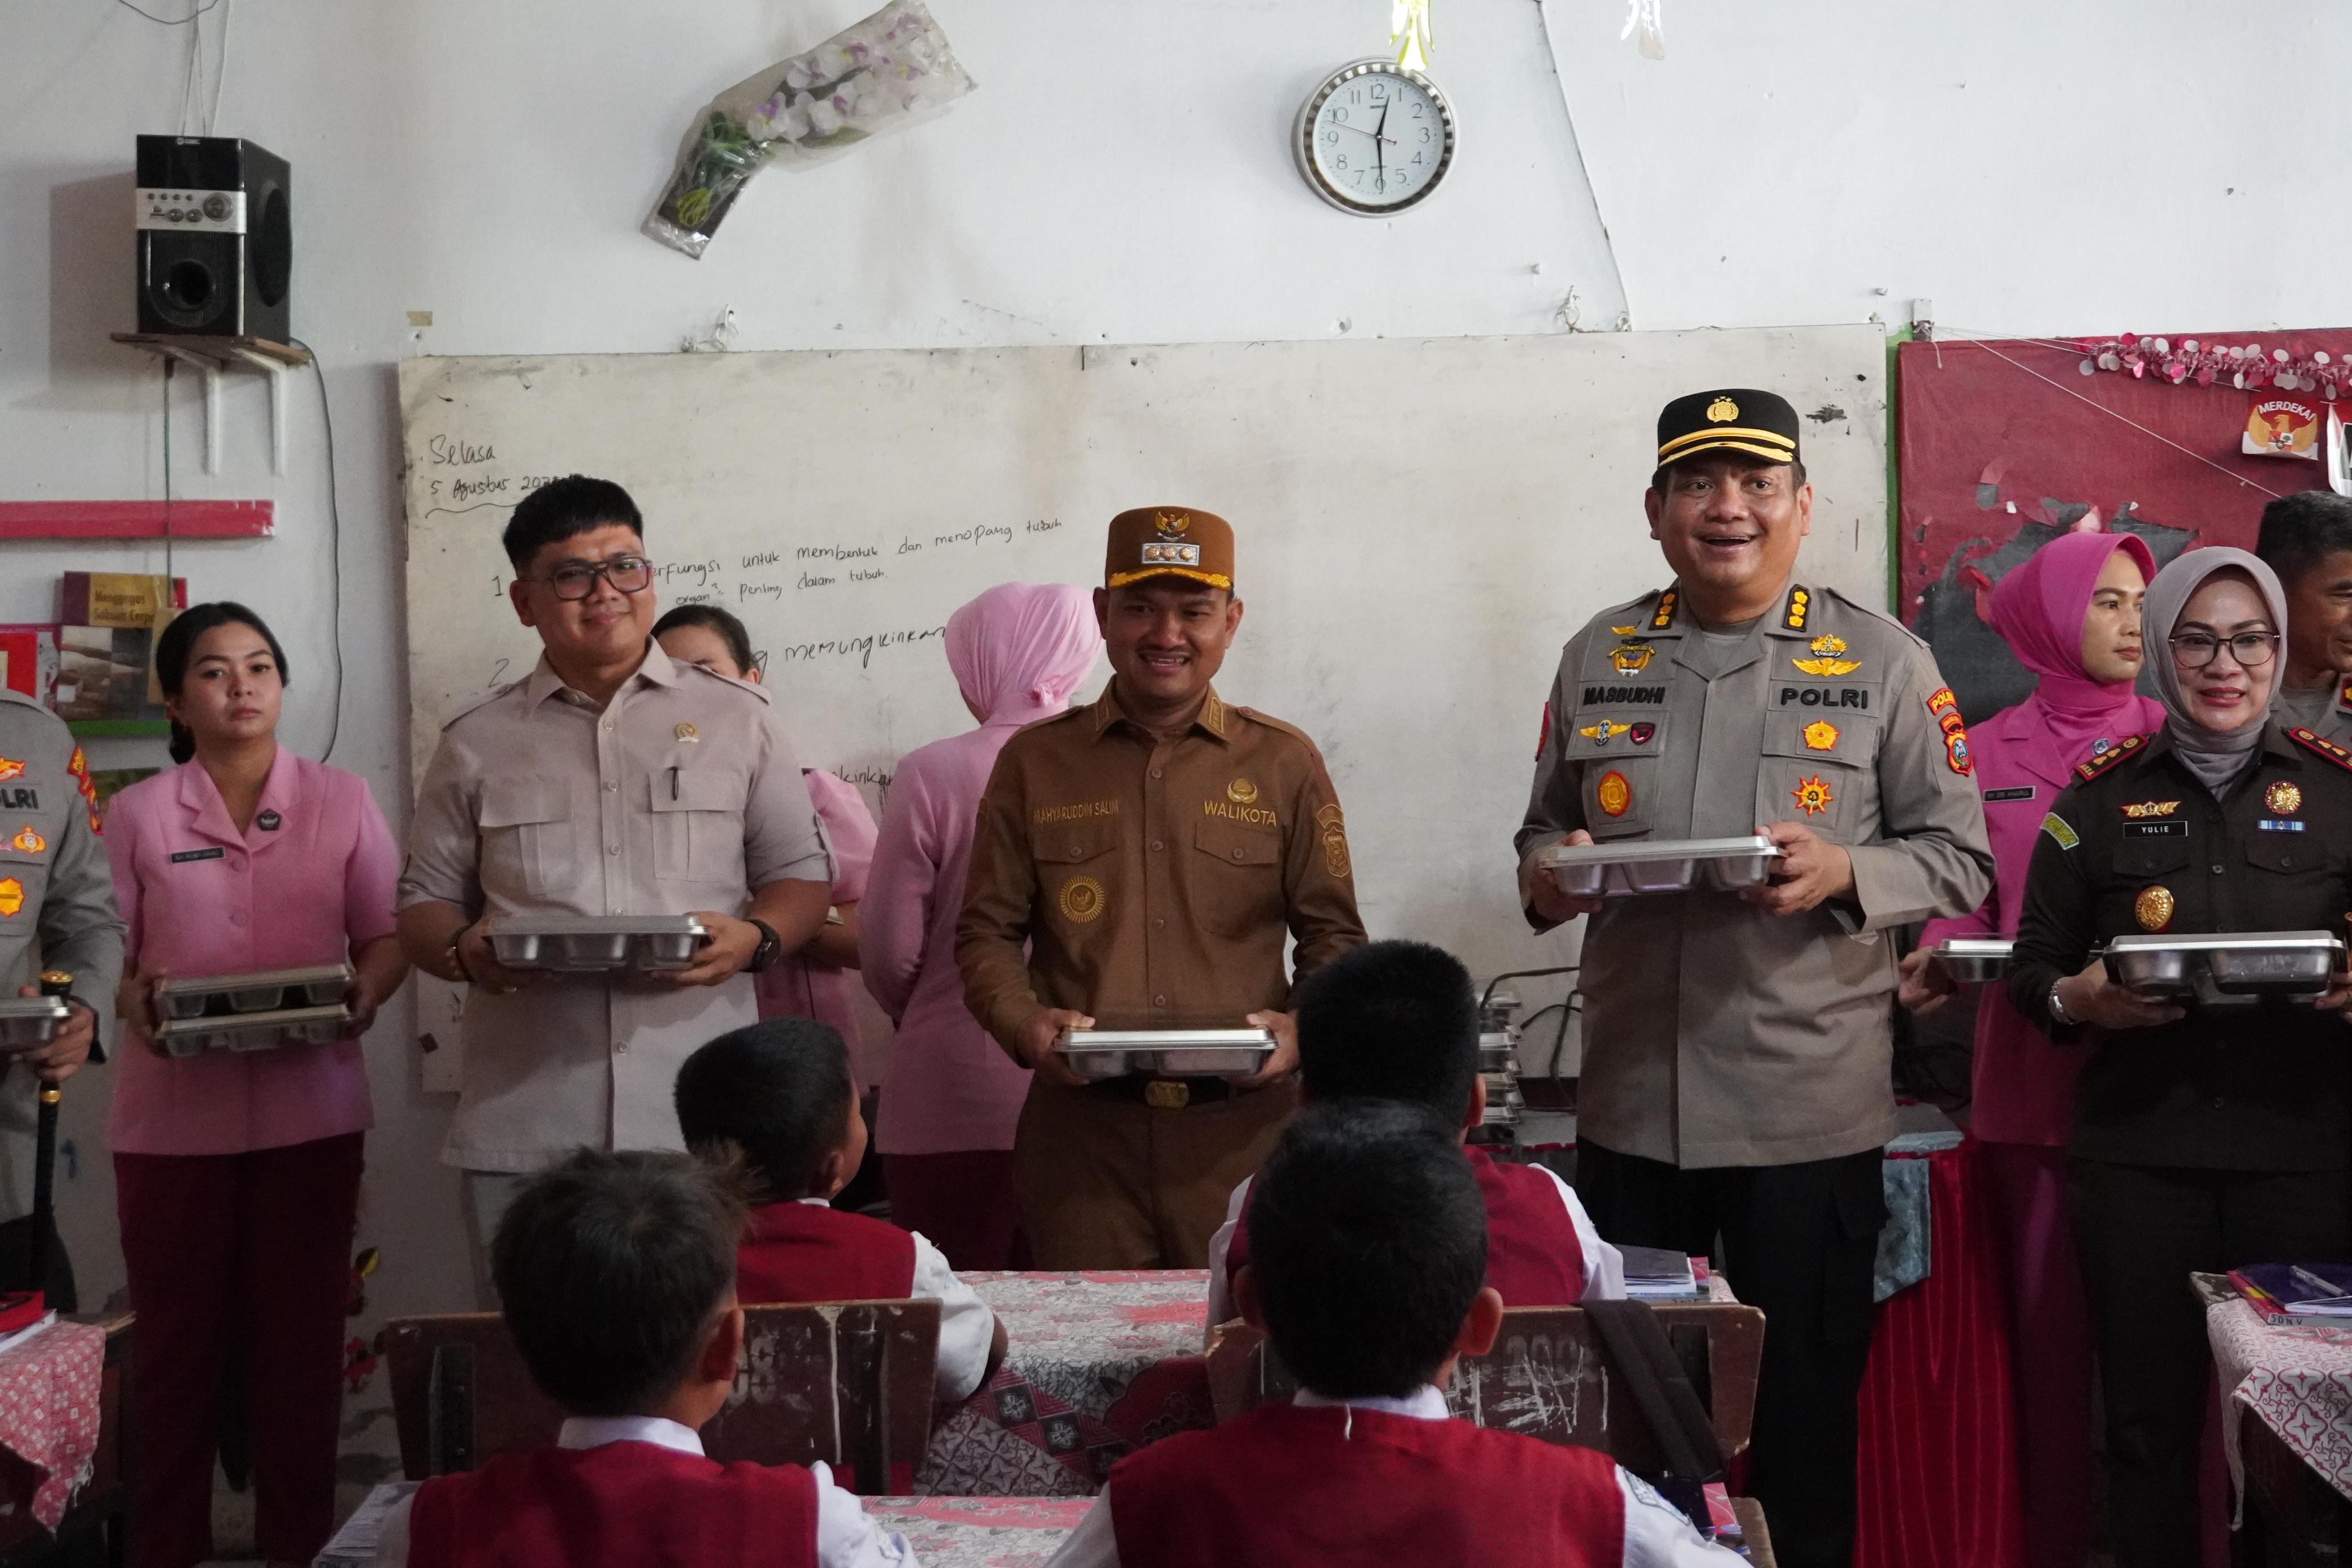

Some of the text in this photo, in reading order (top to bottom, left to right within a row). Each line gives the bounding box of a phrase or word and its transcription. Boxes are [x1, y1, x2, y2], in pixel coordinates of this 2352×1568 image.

[1351, 90, 1361, 104] 11
[1371, 84, 1385, 99] 12
[1398, 88, 1402, 102] 1
[1333, 107, 1348, 123] 10
[1412, 103, 1423, 118] 2
[1328, 131, 1339, 147] 9
[1420, 127, 1430, 144] 3
[1337, 154, 1348, 170] 8
[1411, 151, 1423, 165] 4
[1354, 170, 1365, 185] 7
[1395, 168, 1407, 184] 5
[430, 434, 496, 465] Selasa
[431, 480, 443, 495] 5
[453, 475, 511, 501] Agustus
[742, 551, 780, 568] untuk
[797, 544, 879, 561] membentuk
[897, 535, 922, 555] dan
[797, 571, 836, 590] dalam
[488, 658, 509, 688] 2
[1583, 686, 1666, 706] MASBUDHI
[1780, 687, 1869, 710] POLRI
[0, 788, 40, 810] LRI
[1203, 799, 1278, 828] WALIKOTA
